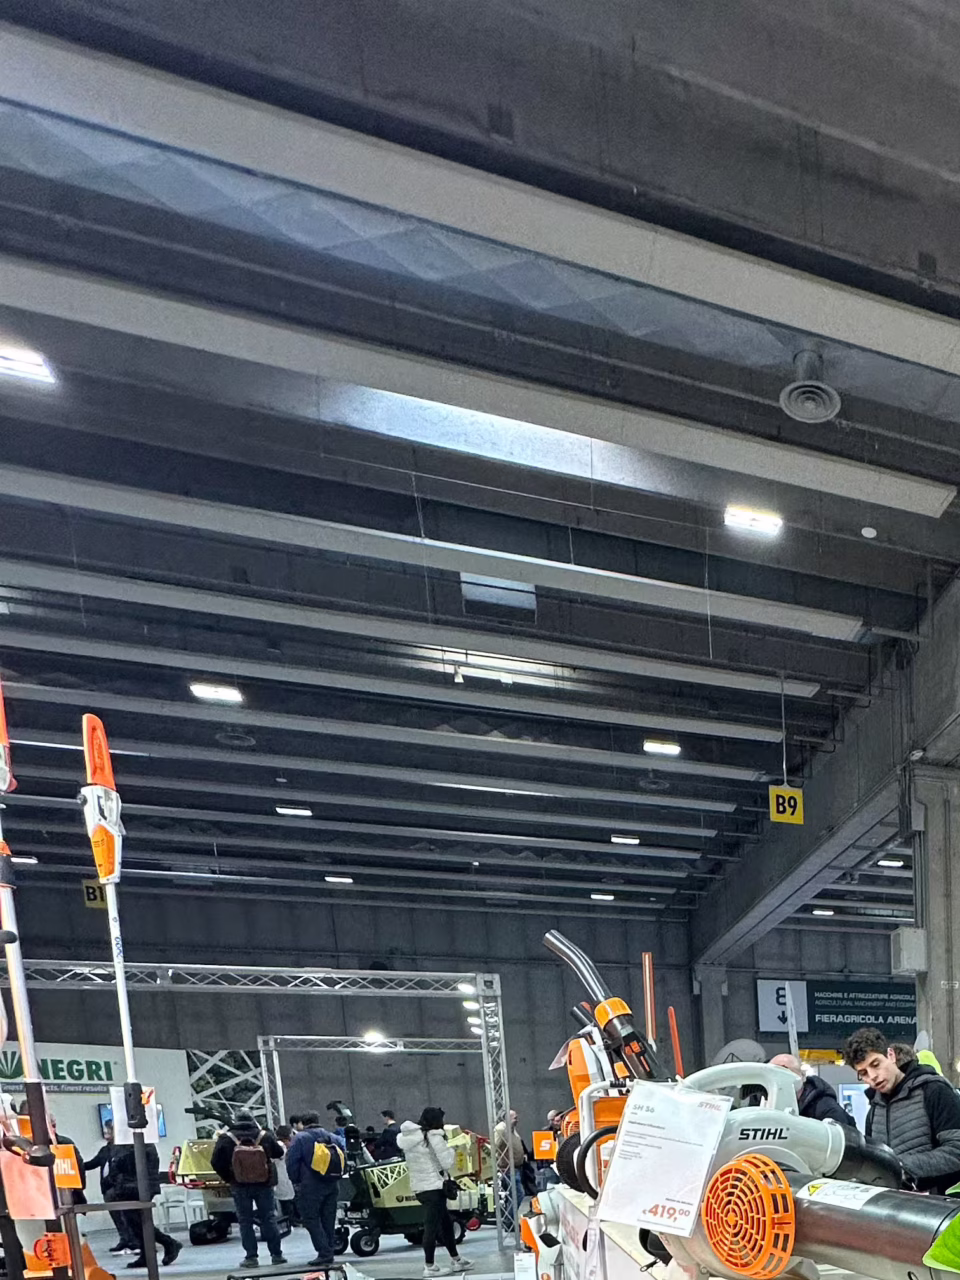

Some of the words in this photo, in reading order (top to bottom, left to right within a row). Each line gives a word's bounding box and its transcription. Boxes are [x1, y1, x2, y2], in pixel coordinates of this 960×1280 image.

[776, 793, 798, 816] B9
[815, 1014, 884, 1024] FIERAGRICOLA
[886, 1015, 918, 1024] ARENA
[37, 1058, 114, 1081] NEGRI
[697, 1101, 723, 1111] STIHL
[738, 1127, 788, 1141] STIHL
